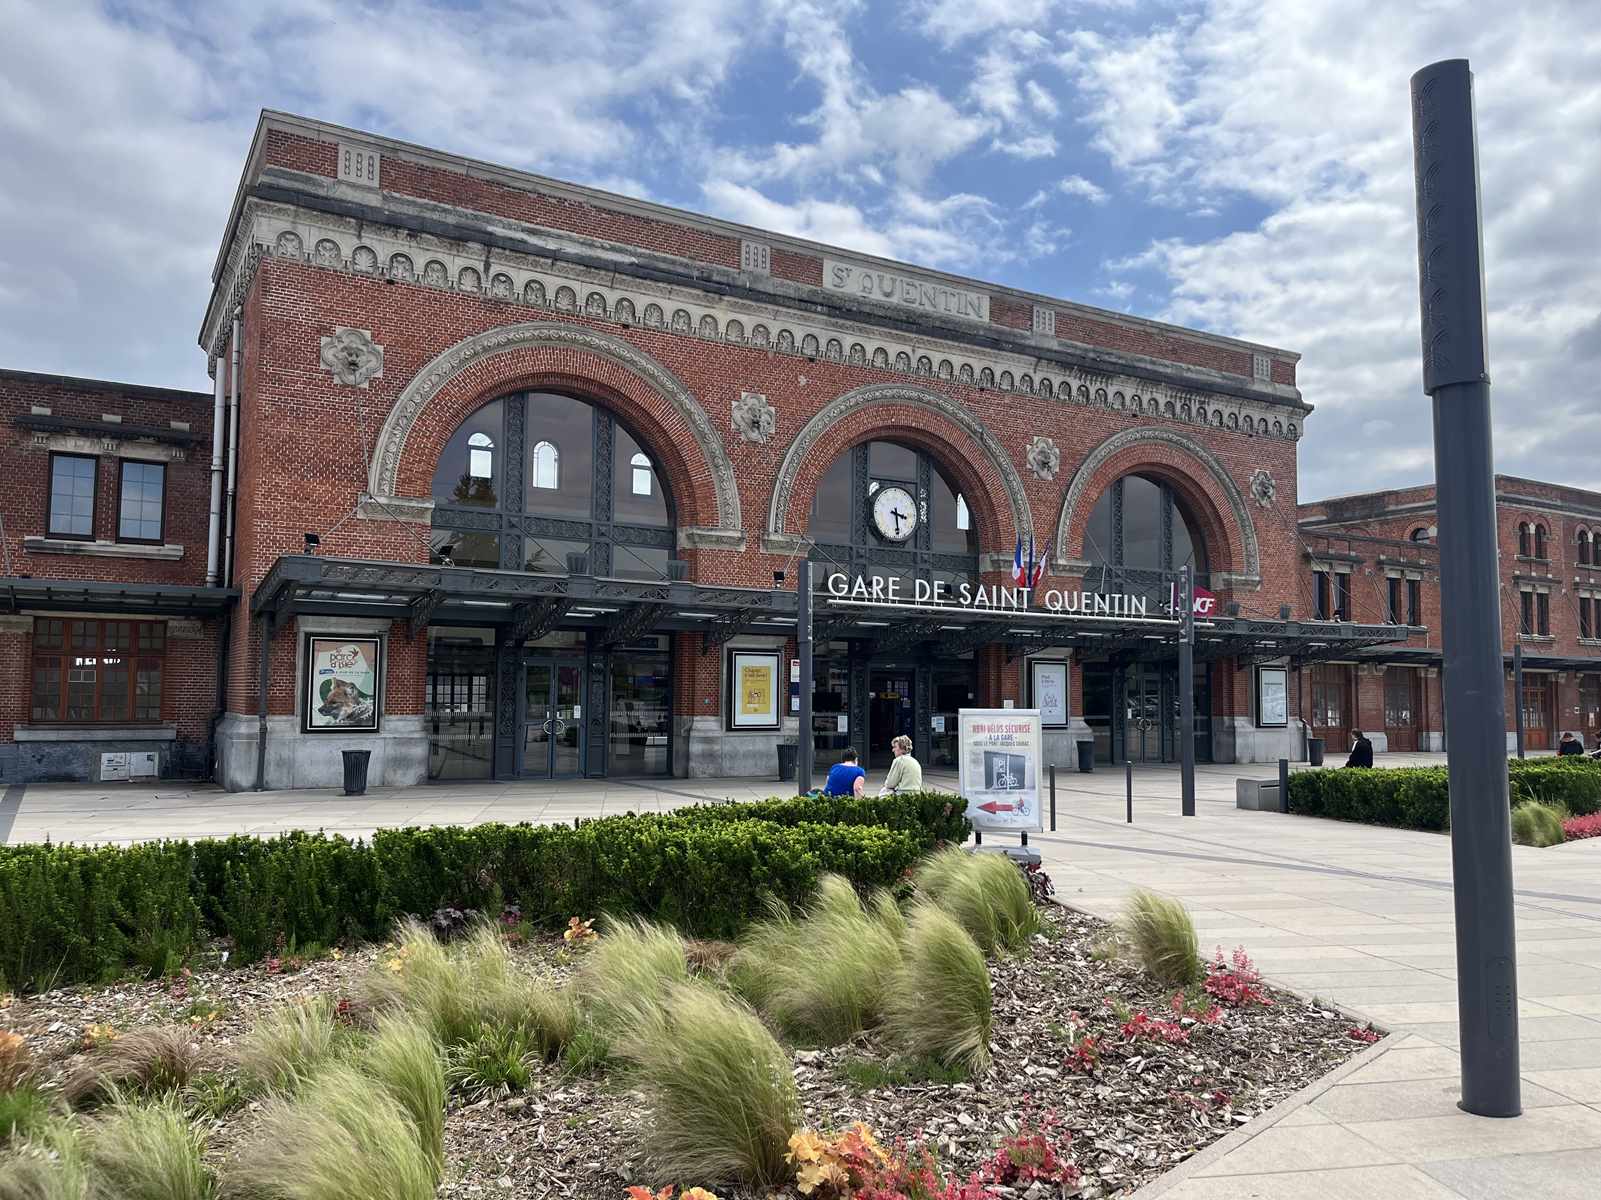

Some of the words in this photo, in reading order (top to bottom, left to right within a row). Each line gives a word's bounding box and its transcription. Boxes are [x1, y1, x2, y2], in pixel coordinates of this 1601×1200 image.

[858, 271, 984, 319] QUENTIN
[827, 573, 901, 600] GARE
[915, 578, 945, 604] DE
[959, 583, 1031, 609] SAINT
[1044, 589, 1147, 616] QUENTIN
